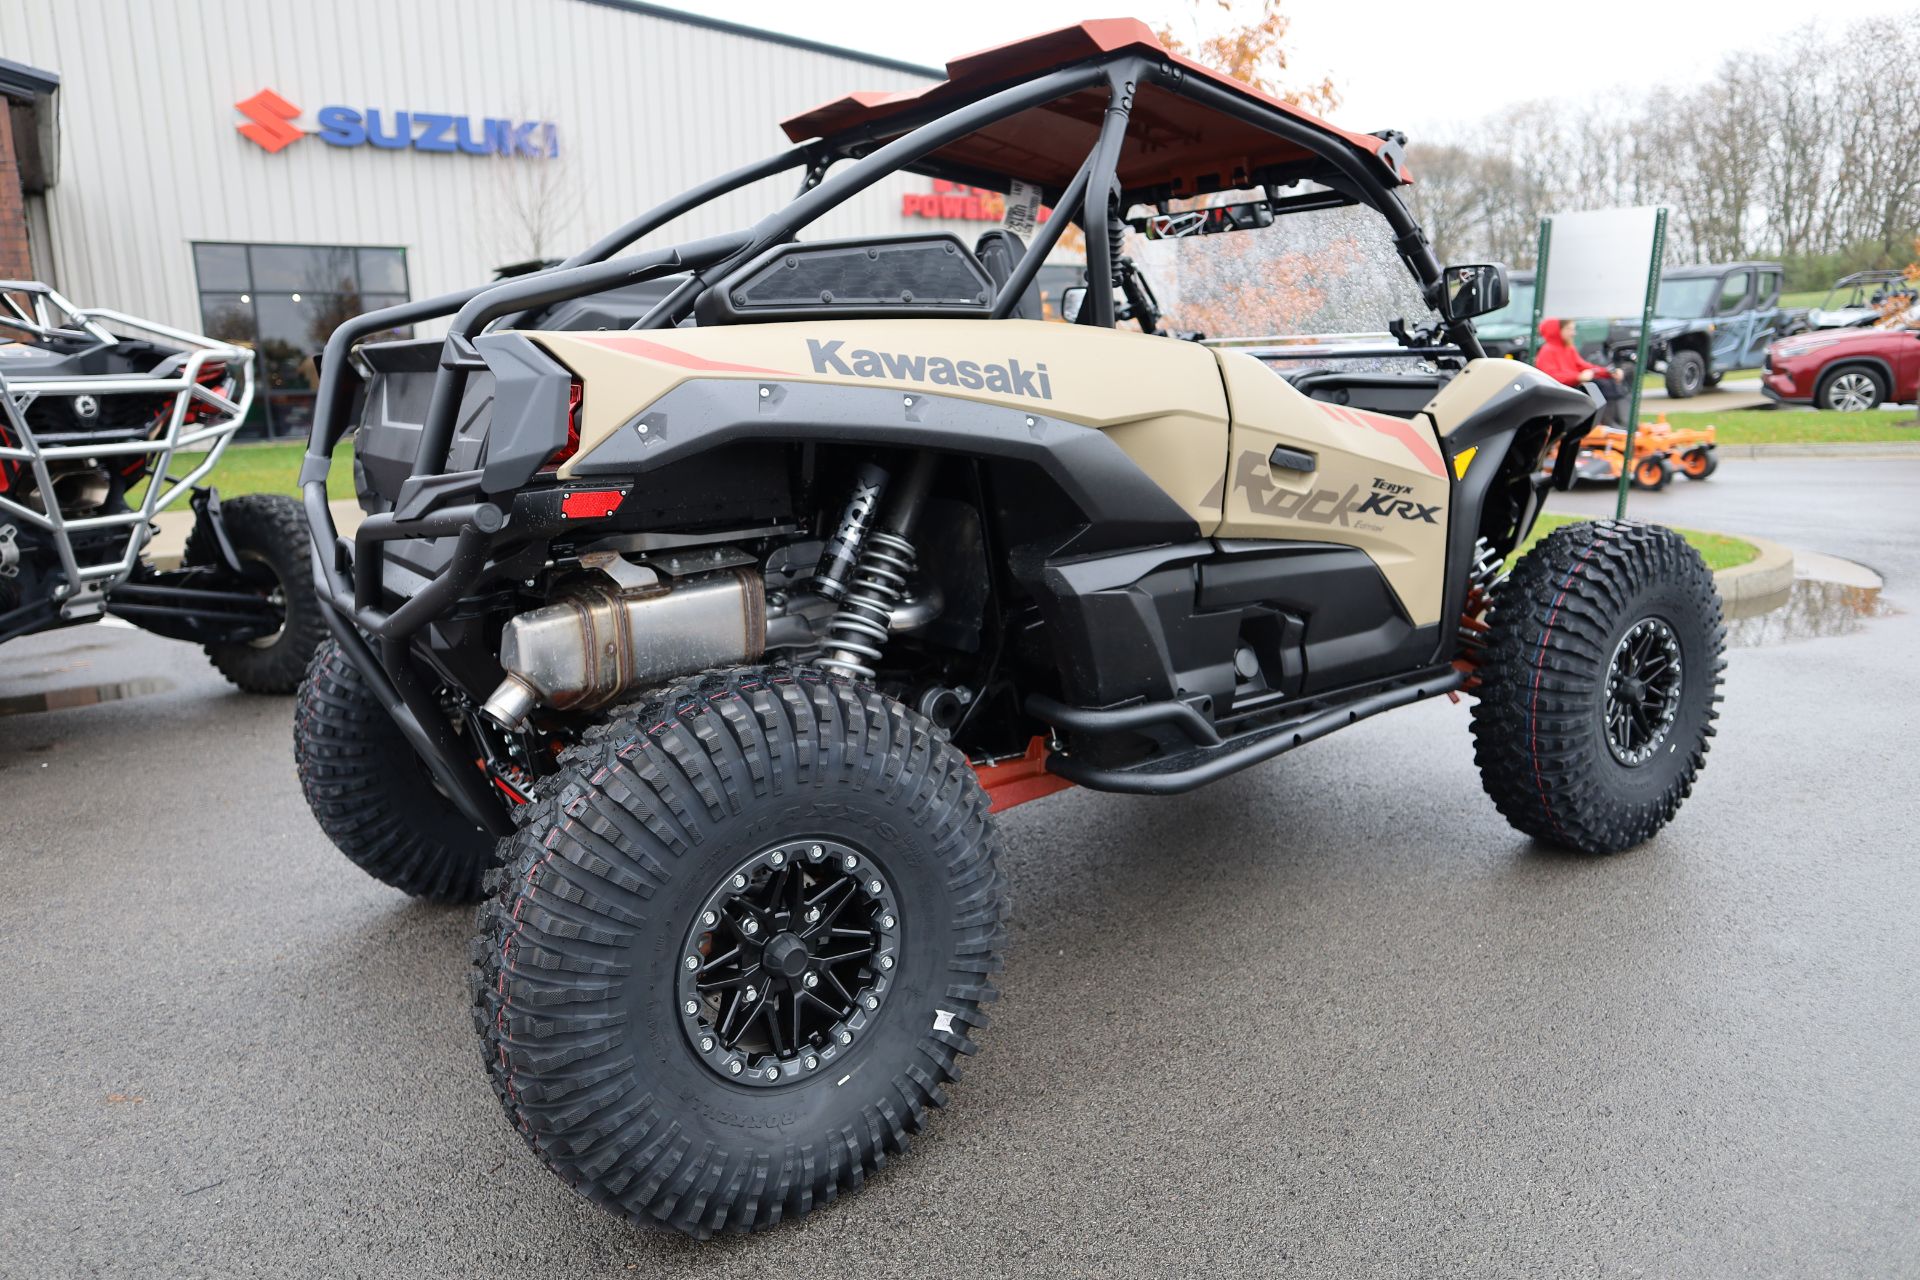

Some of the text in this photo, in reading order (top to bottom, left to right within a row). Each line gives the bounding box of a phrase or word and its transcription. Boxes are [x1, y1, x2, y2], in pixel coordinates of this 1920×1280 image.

[317, 105, 558, 159] SUZUKI
[806, 338, 1053, 400] Kawasaki
[825, 478, 880, 566] FOX
[1357, 491, 1443, 525] KRX
